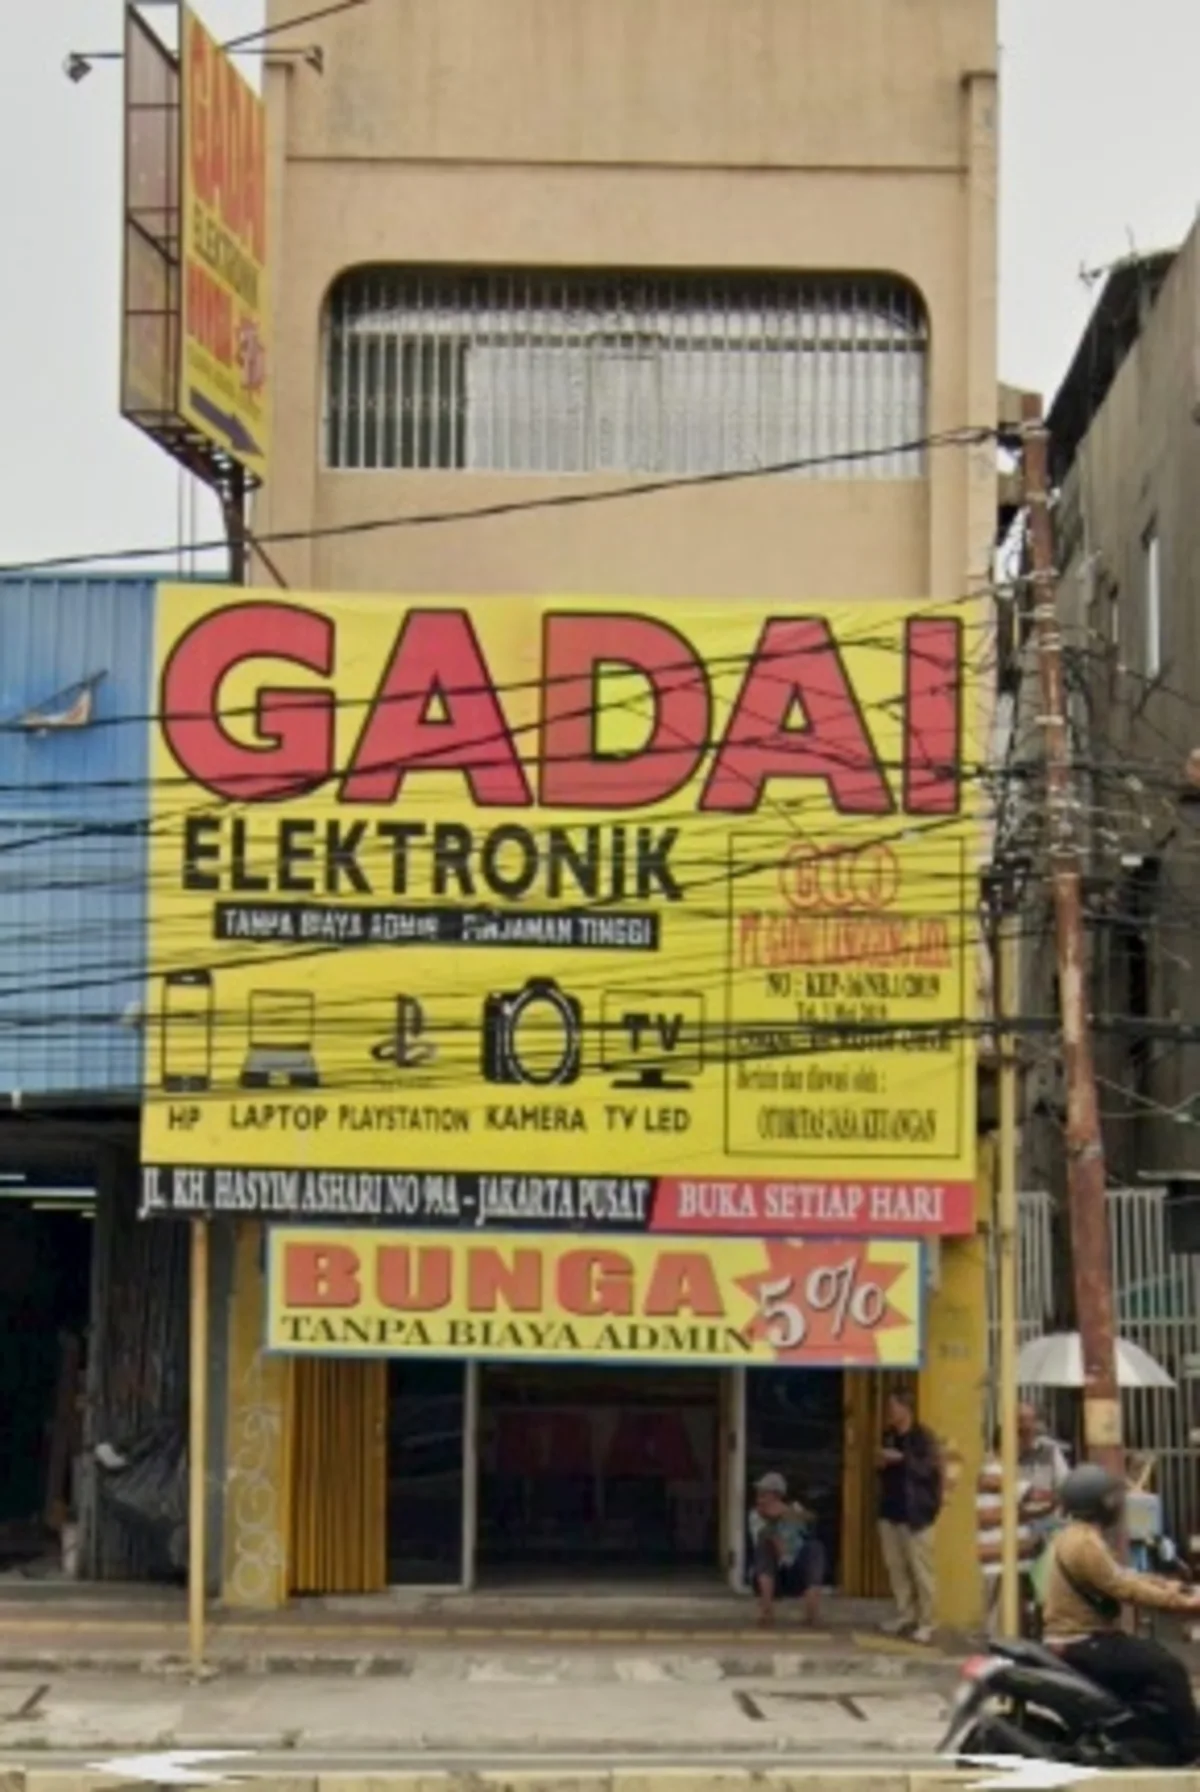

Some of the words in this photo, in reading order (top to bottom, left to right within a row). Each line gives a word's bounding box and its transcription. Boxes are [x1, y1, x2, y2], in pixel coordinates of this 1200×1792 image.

[161, 600, 963, 814] GADAI
[183, 816, 684, 902] ELEKTRONIK
[225, 909, 294, 937] TANPA
[300, 910, 363, 938] BIAYA
[465, 914, 572, 944] PINJAMAN
[579, 918, 651, 944] TINGGI
[621, 1013, 684, 1052] TV
[168, 1105, 202, 1131] HP
[229, 1104, 328, 1131] LAPTOP
[338, 1105, 469, 1132] PLAYSTATION
[484, 1106, 587, 1132] KAMERA
[603, 1107, 637, 1131] TV
[644, 1108, 691, 1133] LED
[214, 1170, 299, 1211] HASYIM
[301, 1173, 381, 1214] ASHARI
[475, 1175, 574, 1227] JAKARTA
[578, 1179, 649, 1221] PUSAT
[678, 1182, 757, 1217] BUKA
[764, 1184, 864, 1220] SETIAP
[869, 1186, 945, 1222] HARI
[284, 1242, 725, 1318] BUNGA
[758, 1257, 886, 1348] 5%
[281, 1314, 431, 1346] TANPA
[447, 1319, 583, 1349] BIAYA
[589, 1323, 752, 1353] ADMIN
